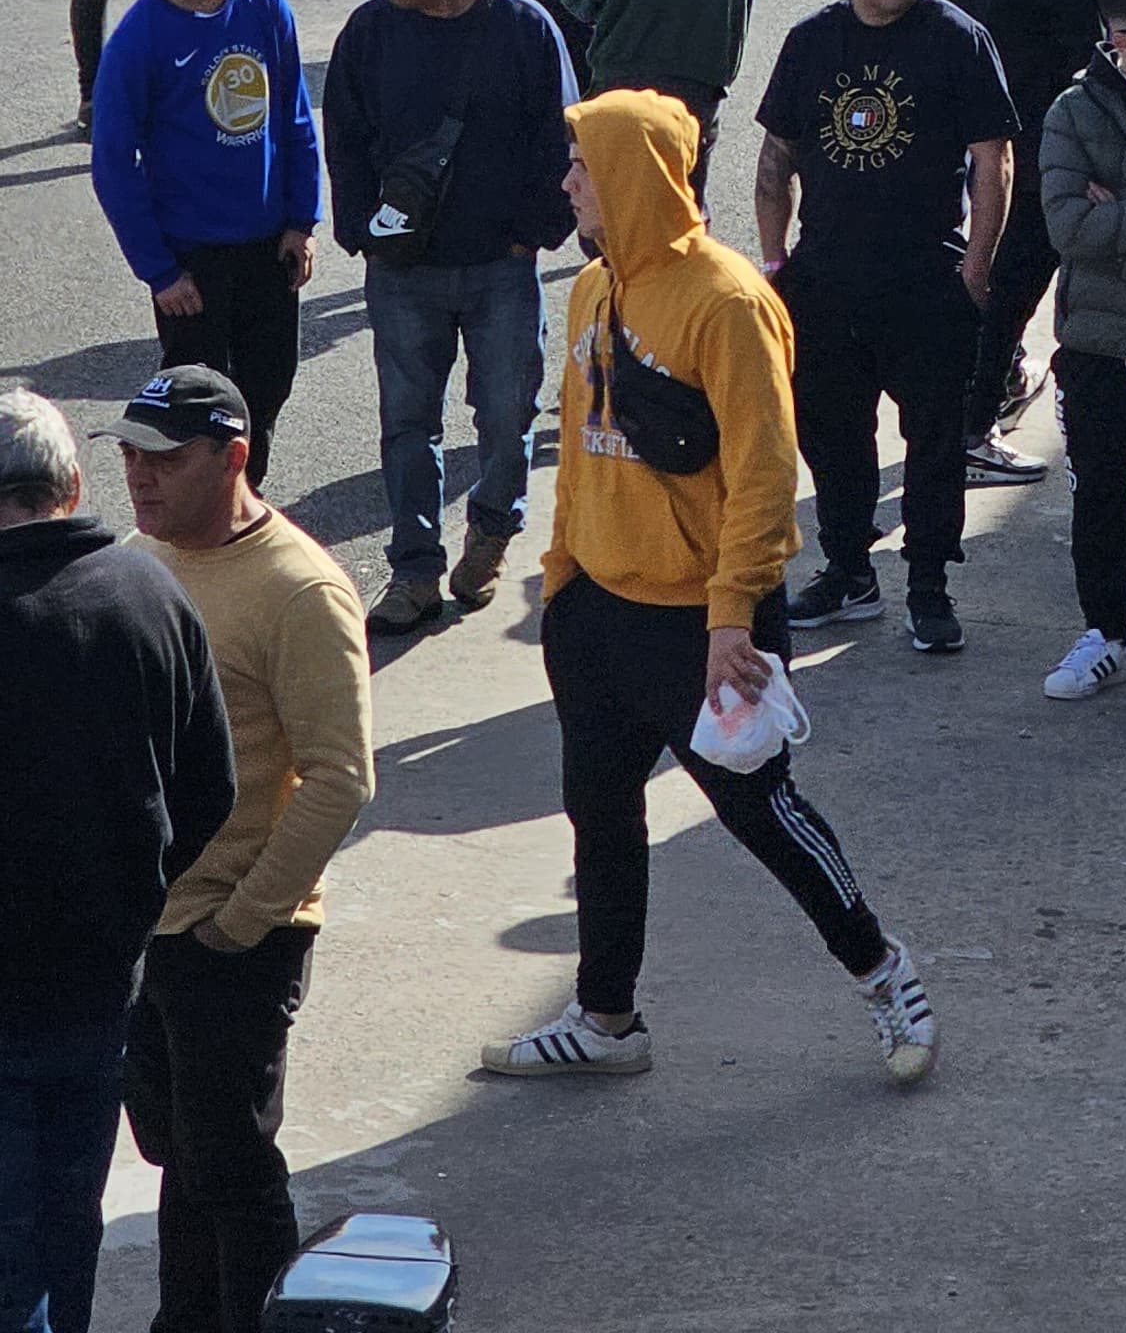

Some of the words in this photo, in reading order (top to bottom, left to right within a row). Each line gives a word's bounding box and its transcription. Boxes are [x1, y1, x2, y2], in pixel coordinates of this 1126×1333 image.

[231, 44, 265, 61] STATE
[225, 65, 255, 90] 30
[818, 64, 916, 104] TOMMY
[819, 125, 916, 172] HILFIGER
[378, 203, 409, 229] NIKE
